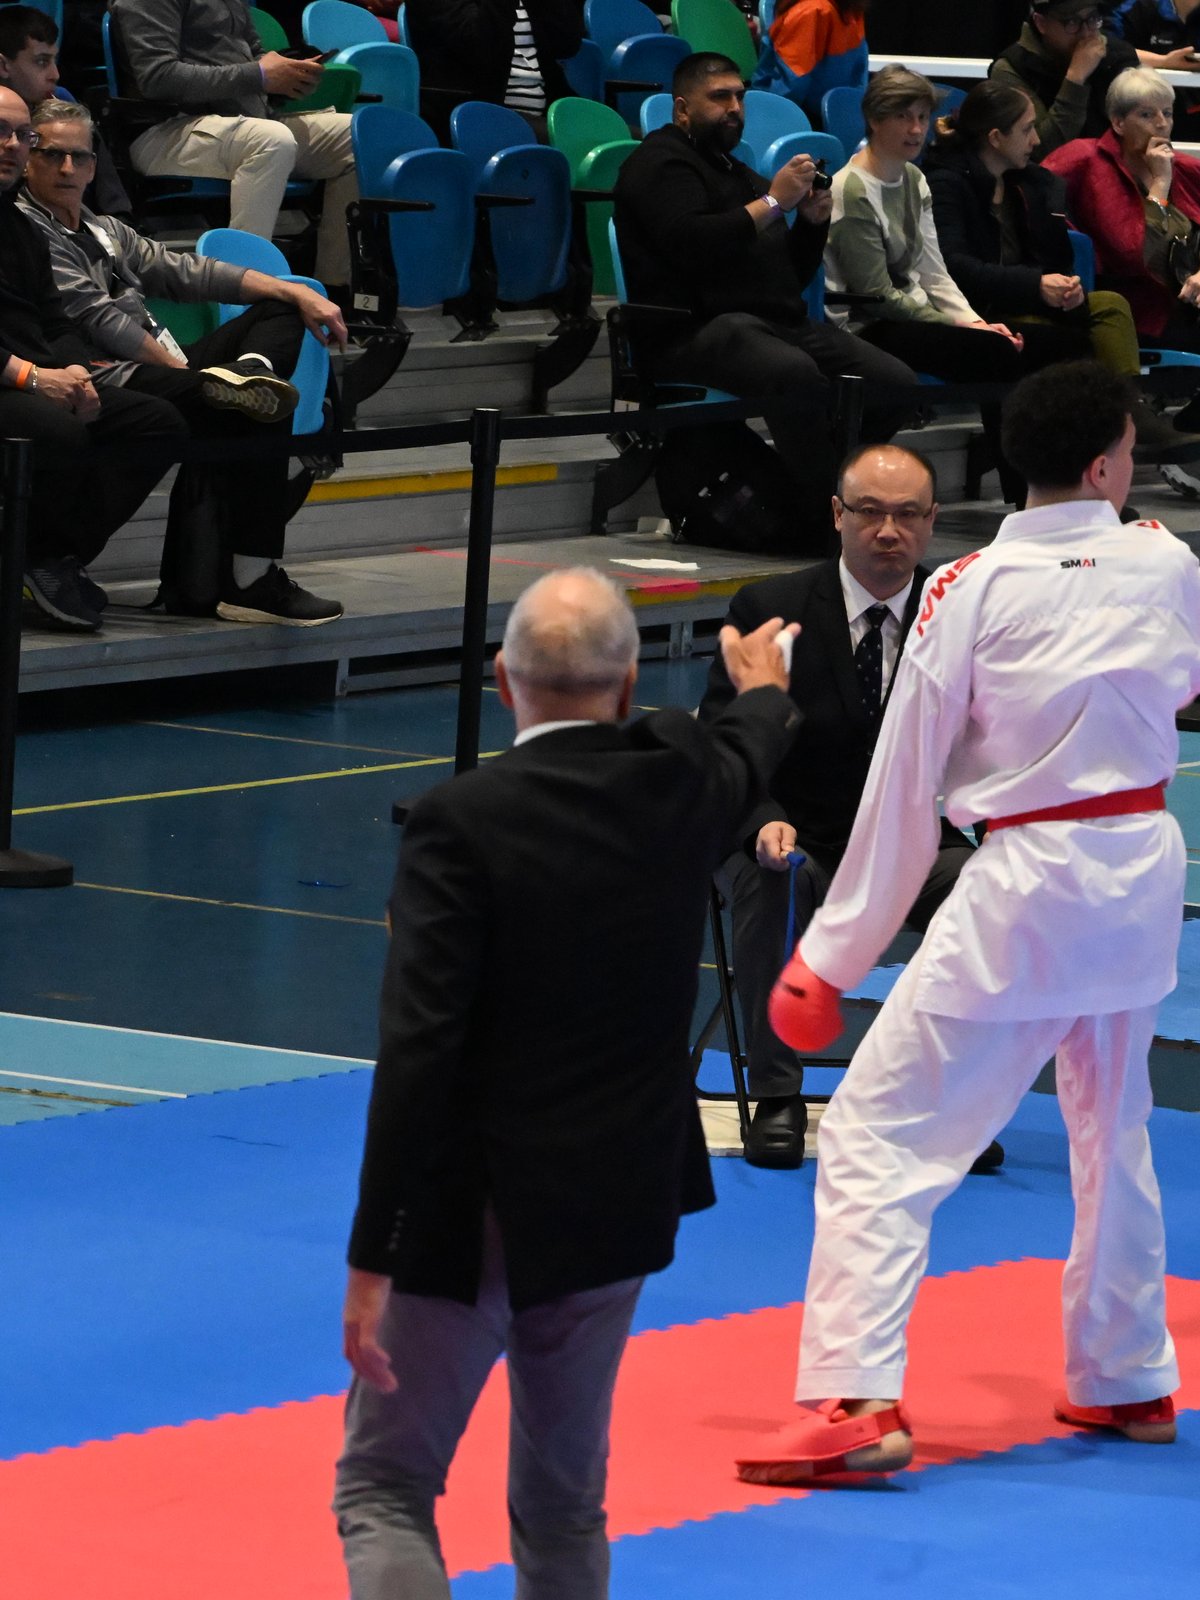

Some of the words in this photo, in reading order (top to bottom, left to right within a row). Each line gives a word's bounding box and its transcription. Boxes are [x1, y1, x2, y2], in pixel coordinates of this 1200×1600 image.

[362, 296, 370, 309] 2
[1060, 558, 1096, 569] SMAI
[917, 552, 981, 638] SMAI
